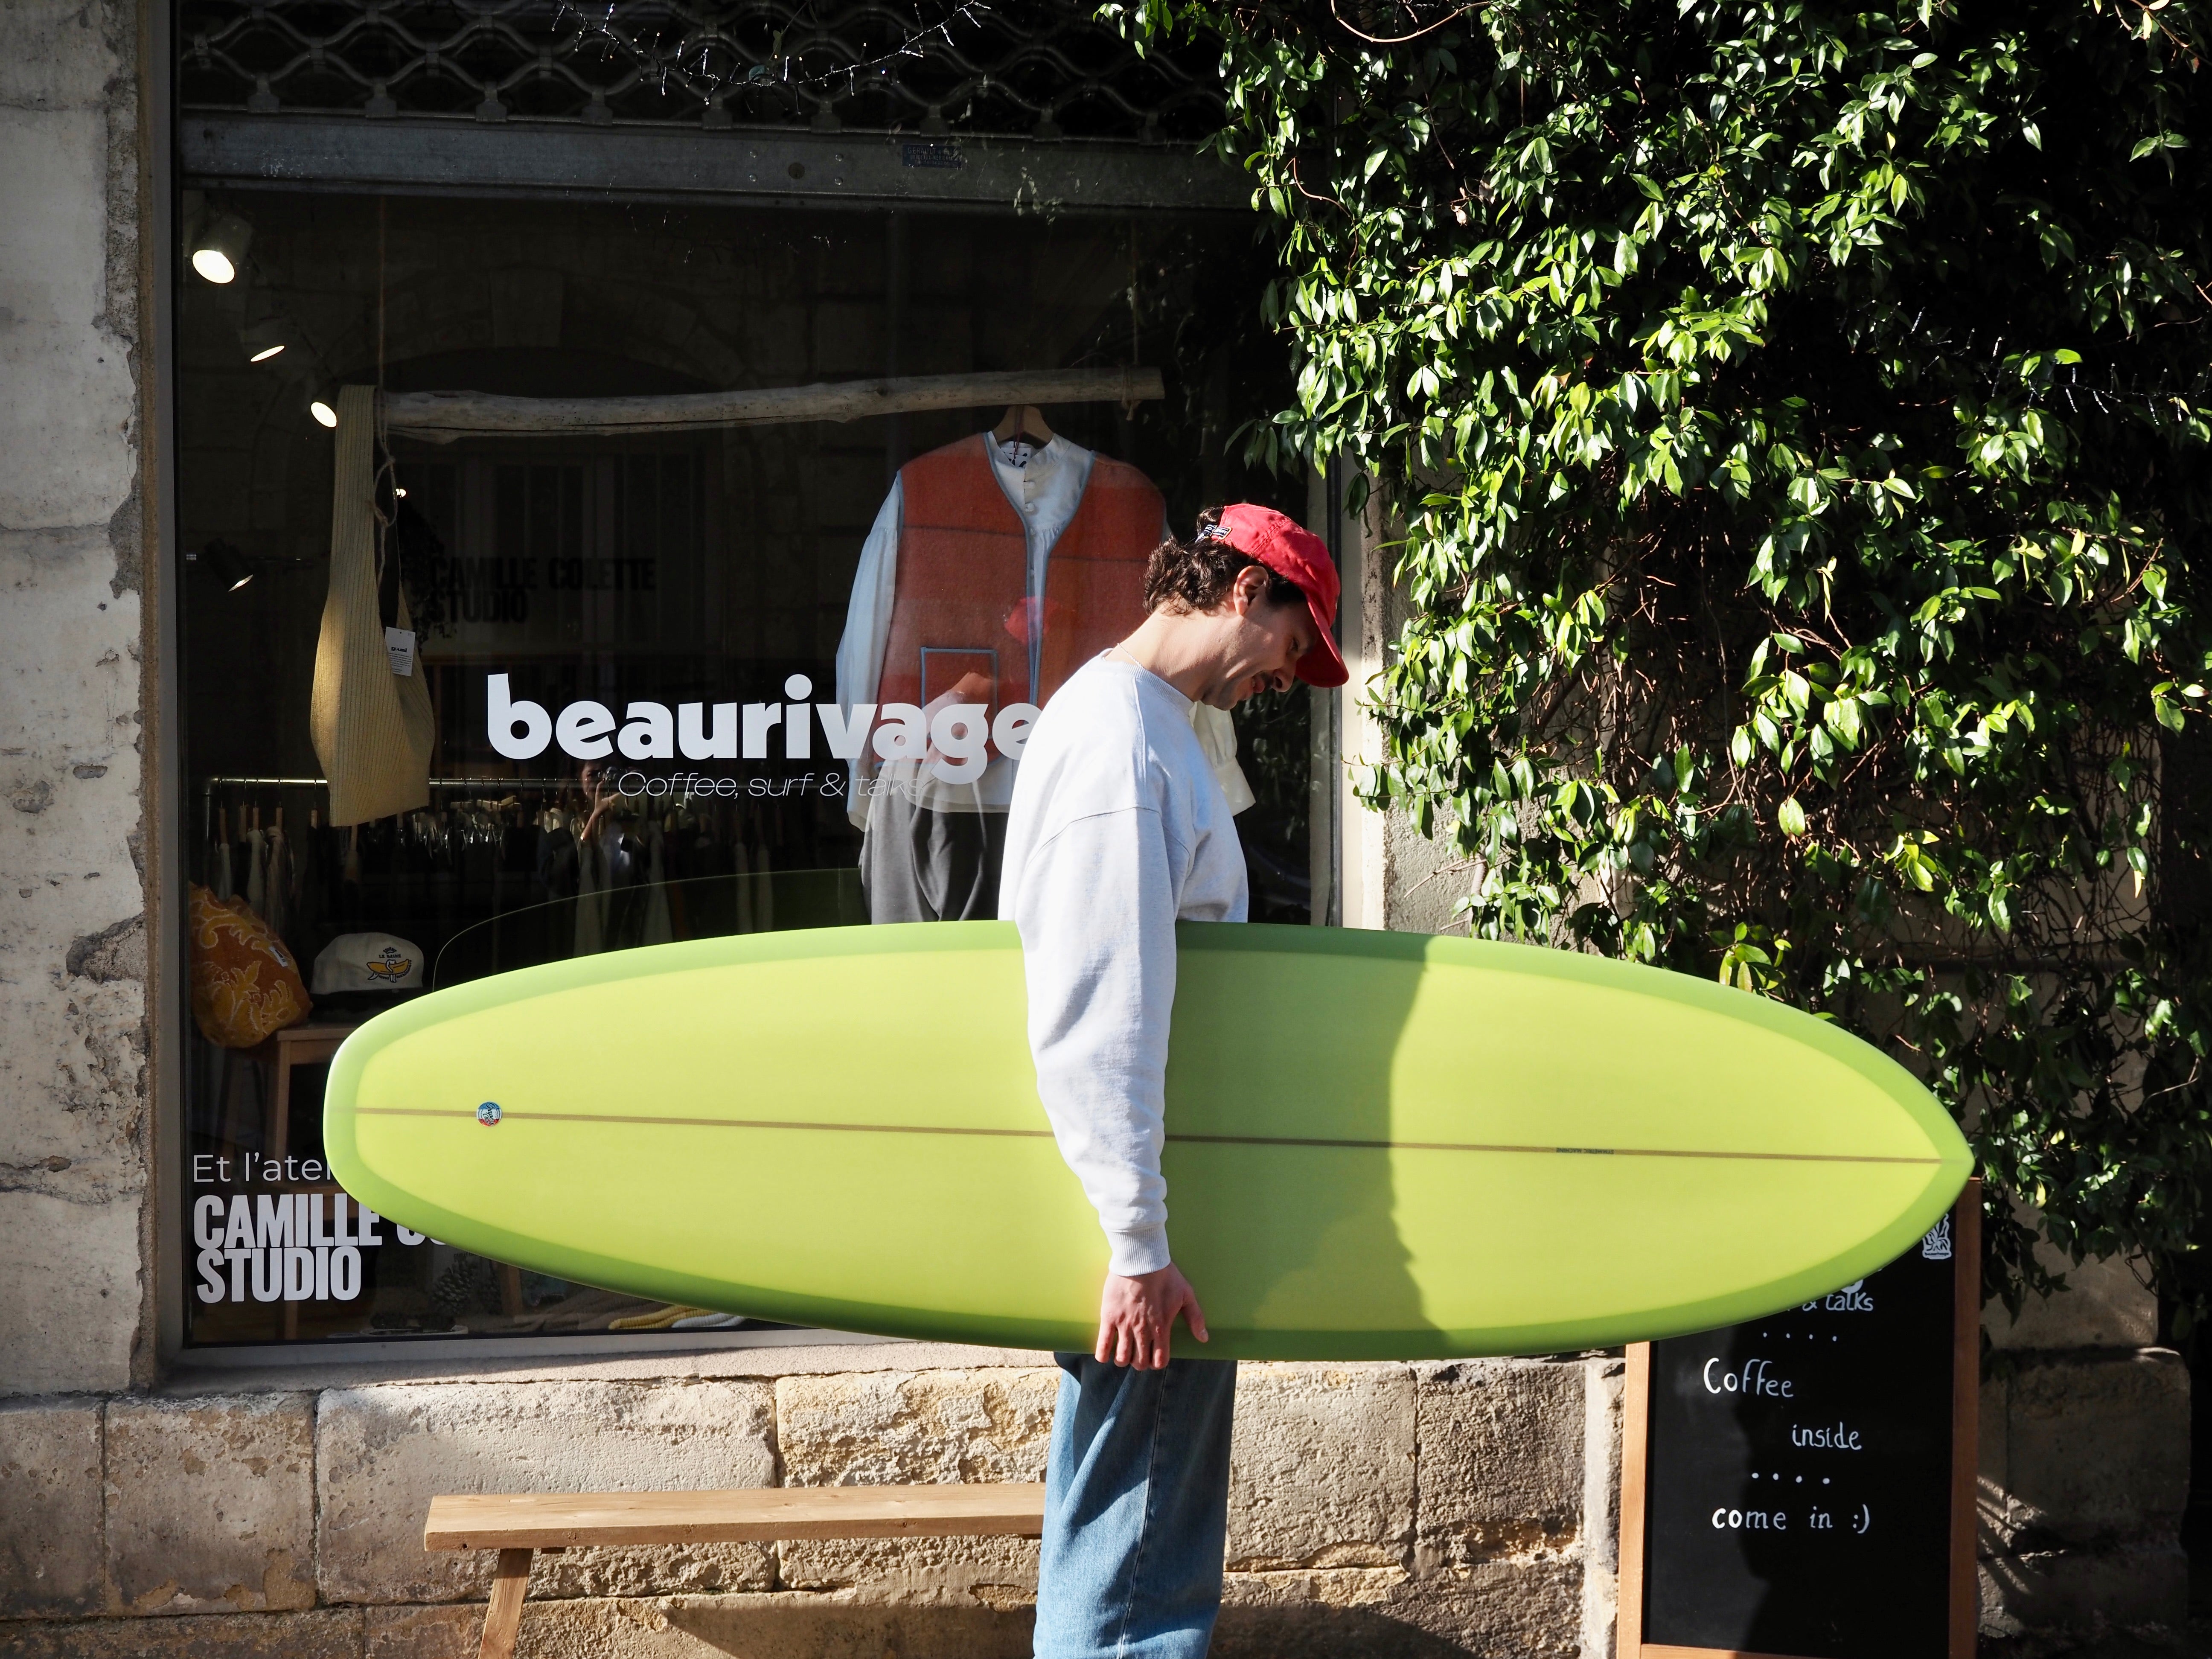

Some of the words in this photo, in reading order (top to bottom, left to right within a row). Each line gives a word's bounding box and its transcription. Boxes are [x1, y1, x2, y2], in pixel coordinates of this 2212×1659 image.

[430, 556, 537, 589] CAMILLE
[548, 557, 656, 590] COLETTE
[488, 673, 1042, 785] beaurivage
[618, 772, 738, 799] Coffee,
[748, 773, 815, 796] surf
[820, 773, 846, 796] &
[855, 773, 925, 796] talks
[194, 1155, 231, 1182] Et
[194, 1193, 383, 1249] CAMILLE
[197, 1246, 361, 1304] STUDIO
[1825, 1292, 1874, 1312] talks
[1703, 1357, 1794, 1397] Coffee
[1792, 1422, 1862, 1450] inside
[1711, 1507, 1786, 1530] come
[1809, 1506, 1833, 1529] in
